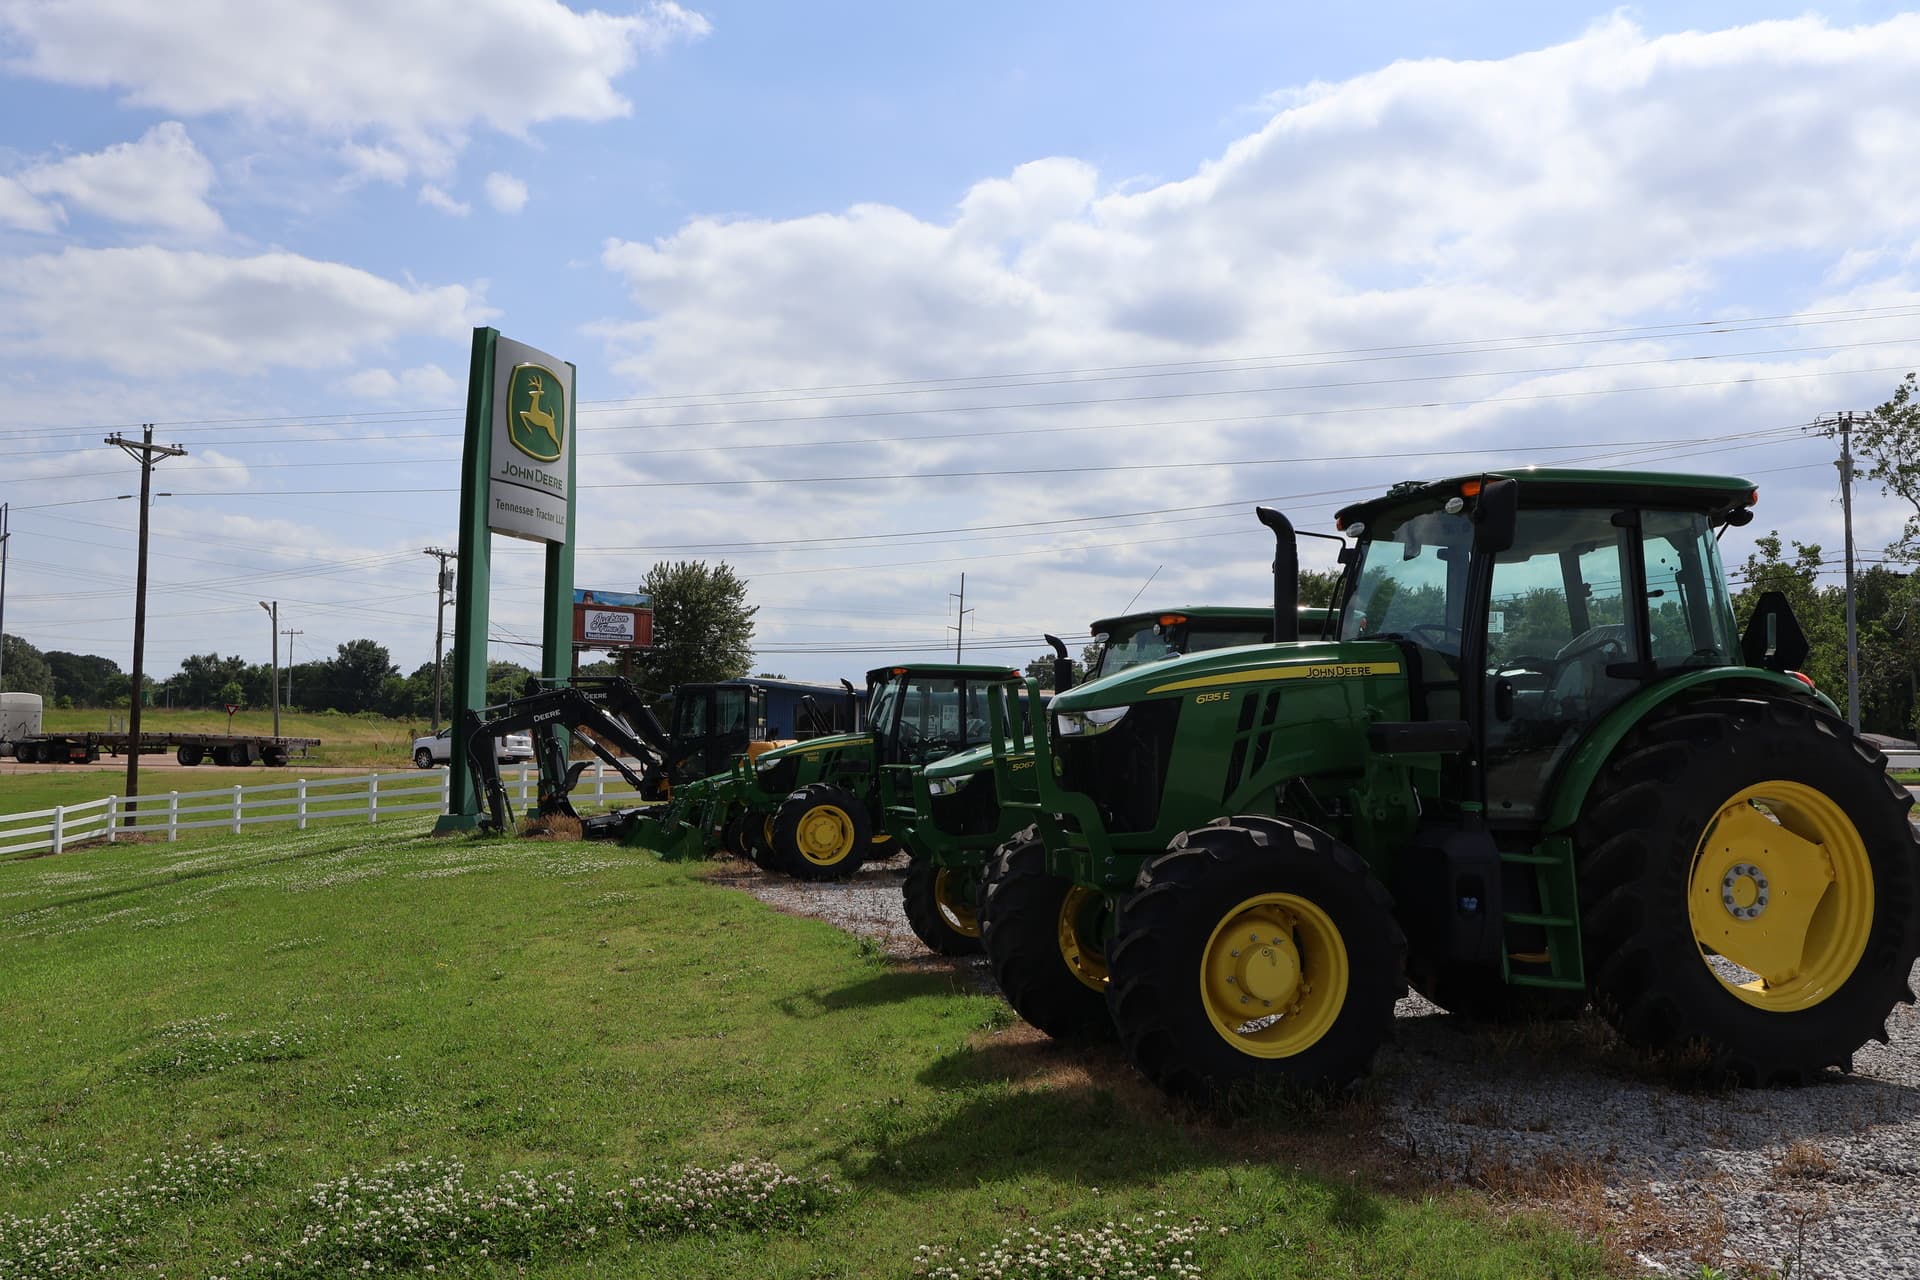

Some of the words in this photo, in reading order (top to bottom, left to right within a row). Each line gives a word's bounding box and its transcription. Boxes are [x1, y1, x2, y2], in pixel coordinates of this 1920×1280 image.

[501, 461, 534, 481] JOHN
[535, 469, 563, 490] DEERE
[496, 498, 534, 516] Tennessee
[536, 507, 555, 522] Tractor
[1306, 666, 1336, 678] JOHN
[1336, 666, 1372, 677] DEERE
[583, 691, 608, 700] DEERE
[1196, 692, 1221, 704] 6135
[1223, 691, 1231, 700] E
[533, 709, 561, 722] DEERE
